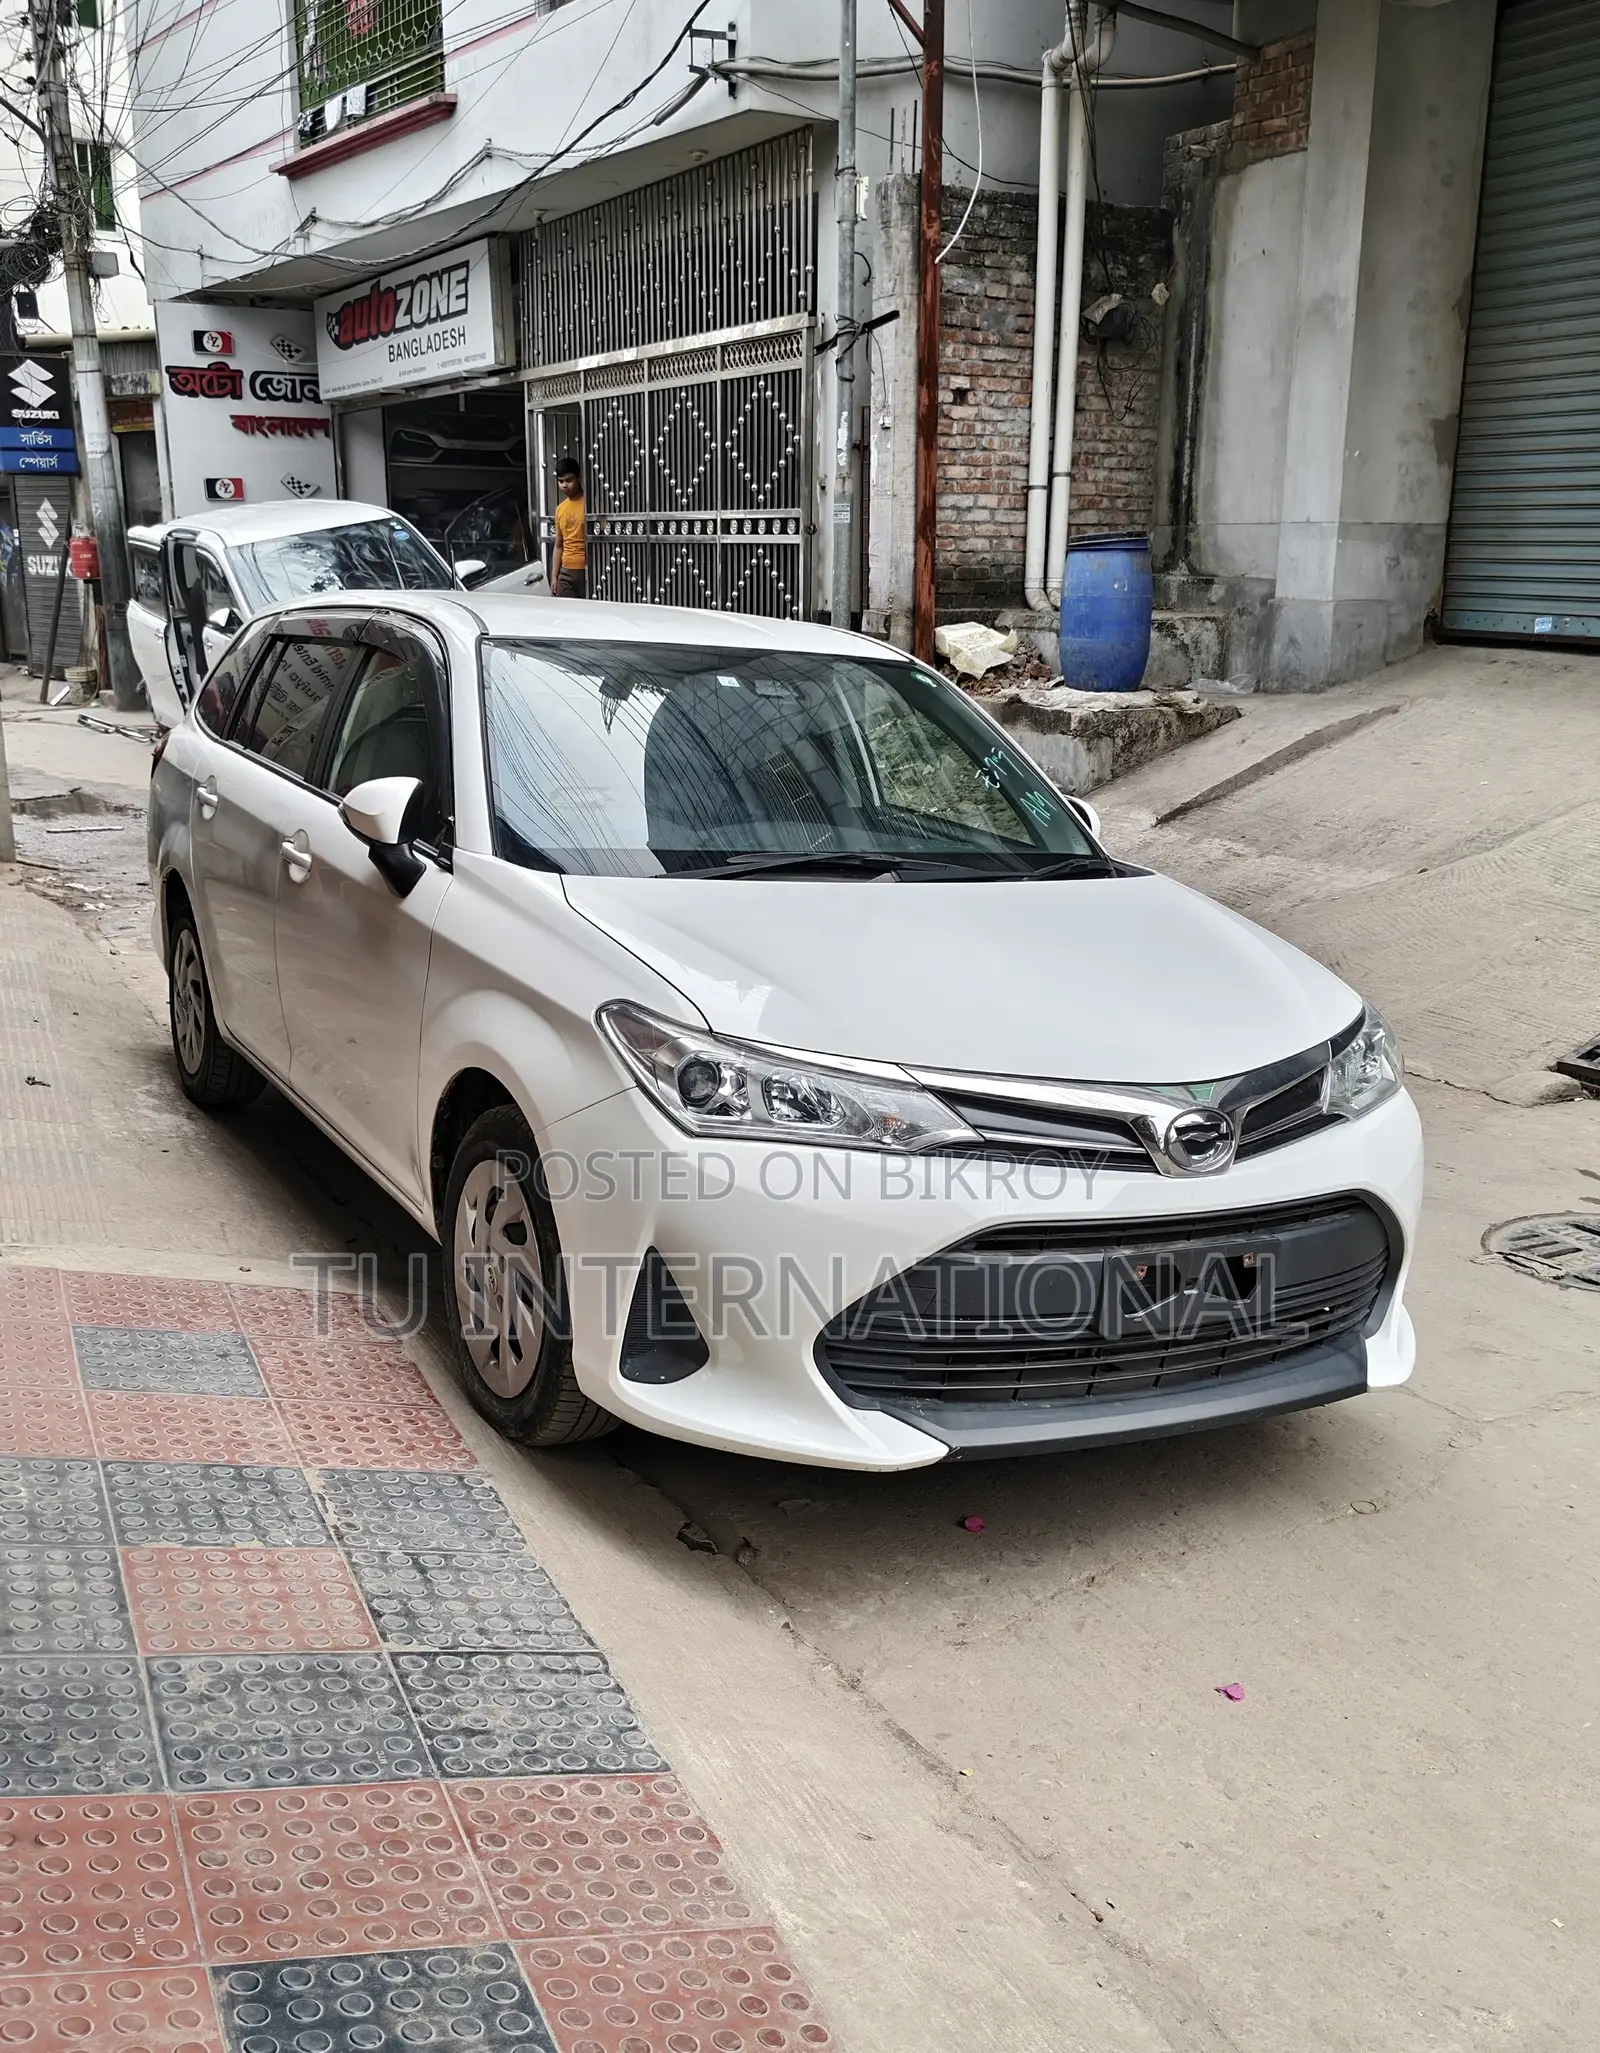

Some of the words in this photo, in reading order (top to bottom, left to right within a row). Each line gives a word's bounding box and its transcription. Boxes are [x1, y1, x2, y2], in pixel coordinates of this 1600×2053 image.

[388, 325, 466, 363] BANGLADESH
[165, 361, 243, 399] অটো
[11, 409, 60, 420] SUZUKI
[230, 415, 331, 438] বাংলাদেশ
[20, 430, 53, 446] সার্ভিস
[19, 454, 58, 469] স্পেয়ার্স
